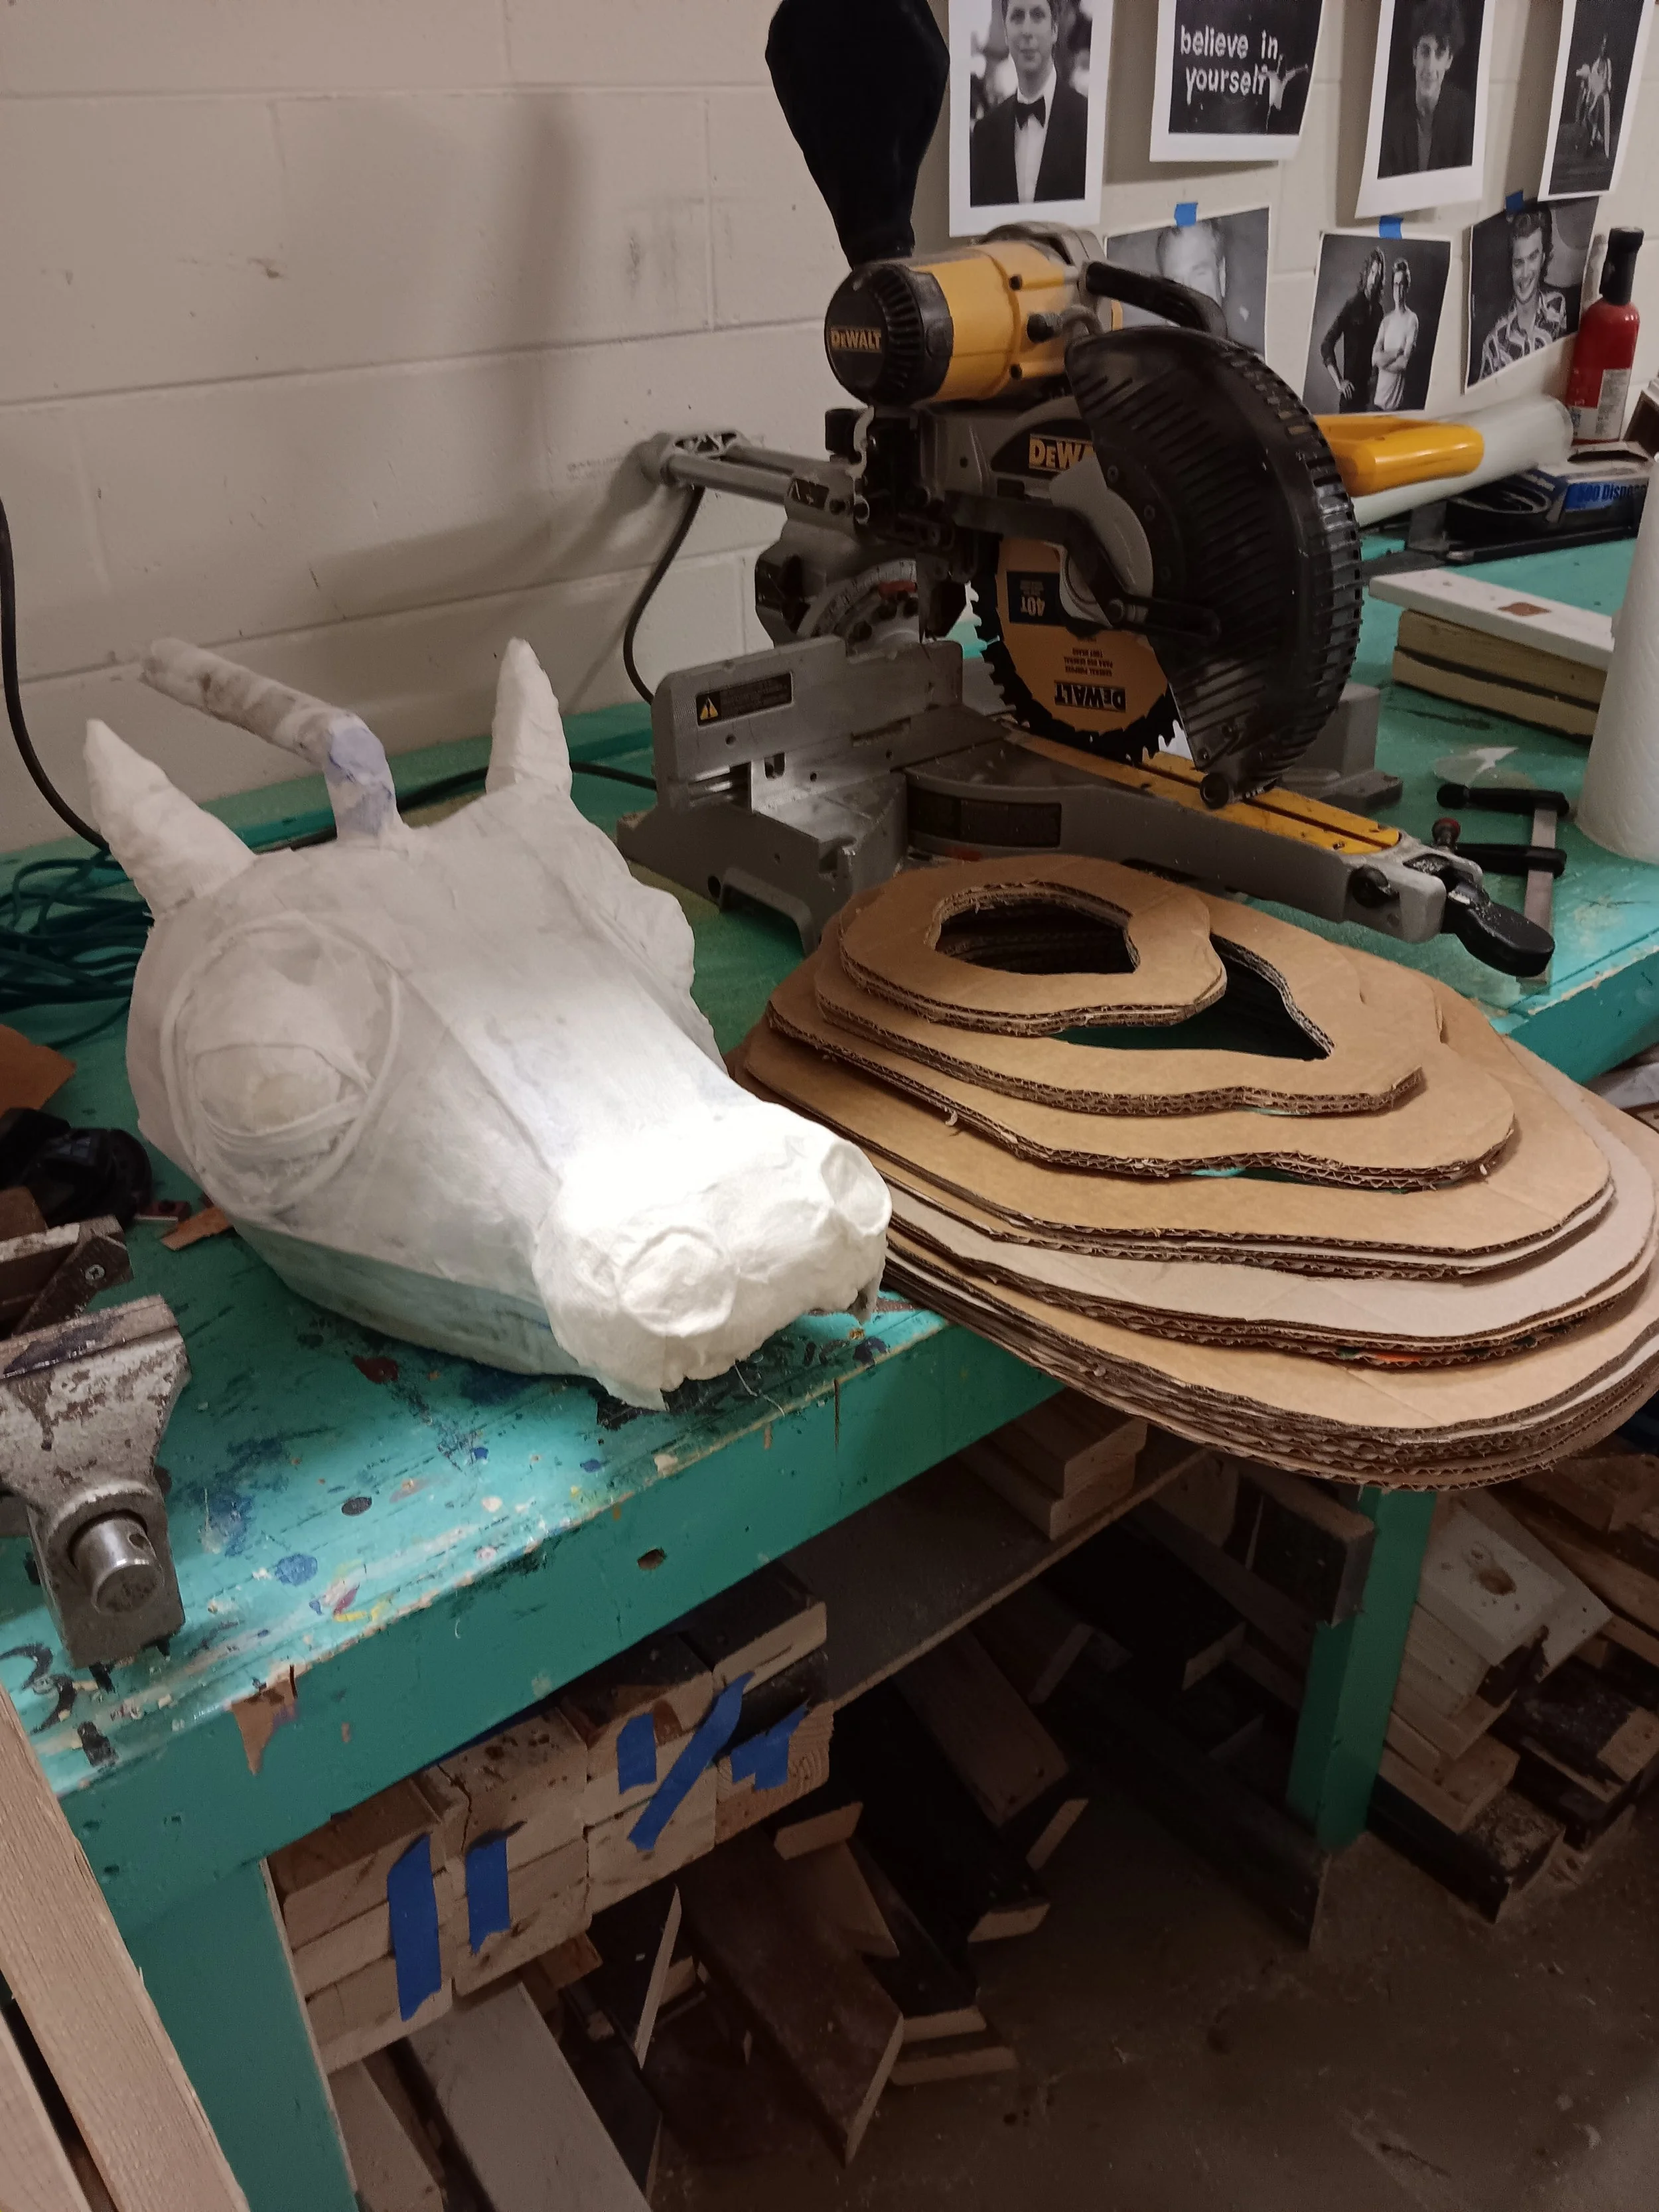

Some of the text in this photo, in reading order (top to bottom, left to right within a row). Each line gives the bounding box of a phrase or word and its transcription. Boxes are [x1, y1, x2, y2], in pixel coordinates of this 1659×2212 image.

[1180, 24, 1278, 60] believe in
[1185, 64, 1268, 106] yourself
[1056, 682, 1126, 711] DEWALT
